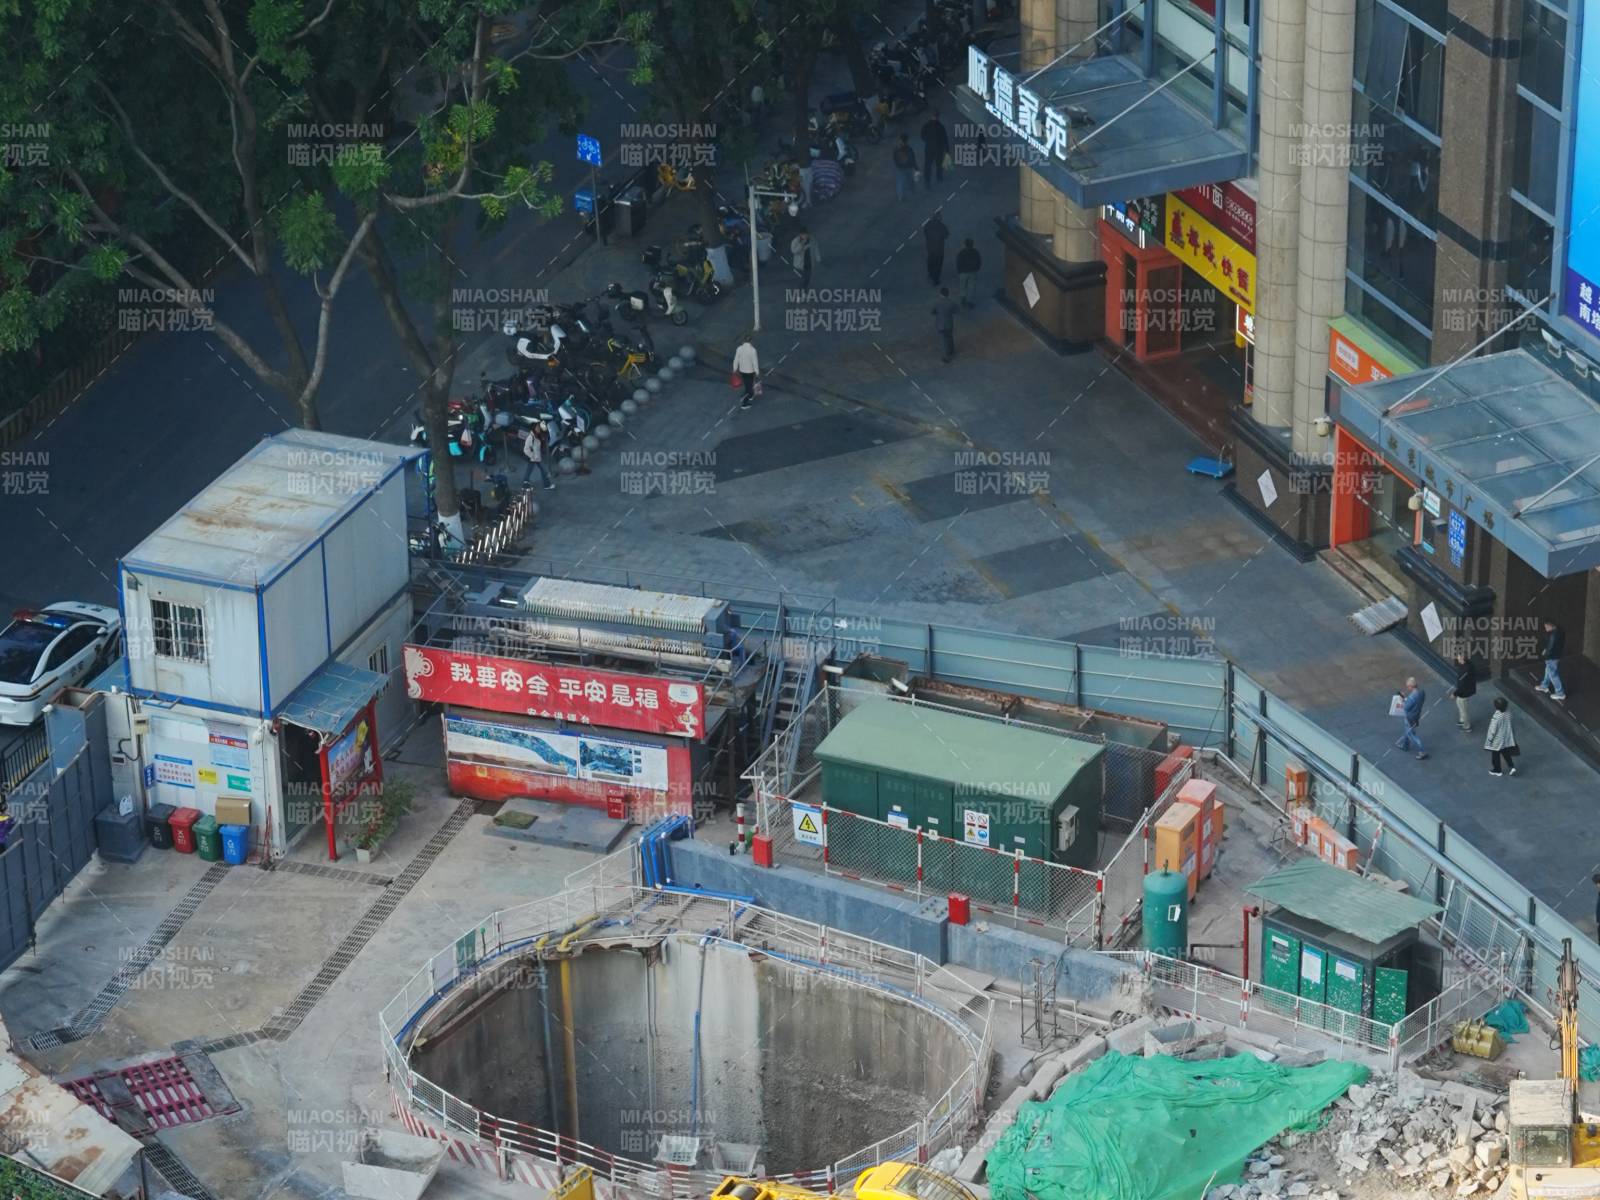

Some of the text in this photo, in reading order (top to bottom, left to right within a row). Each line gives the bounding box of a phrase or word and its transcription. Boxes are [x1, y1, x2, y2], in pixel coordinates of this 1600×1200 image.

[968, 45, 1068, 160] 顺德家苑
[450, 661, 659, 710] 我要安全 平安是福
